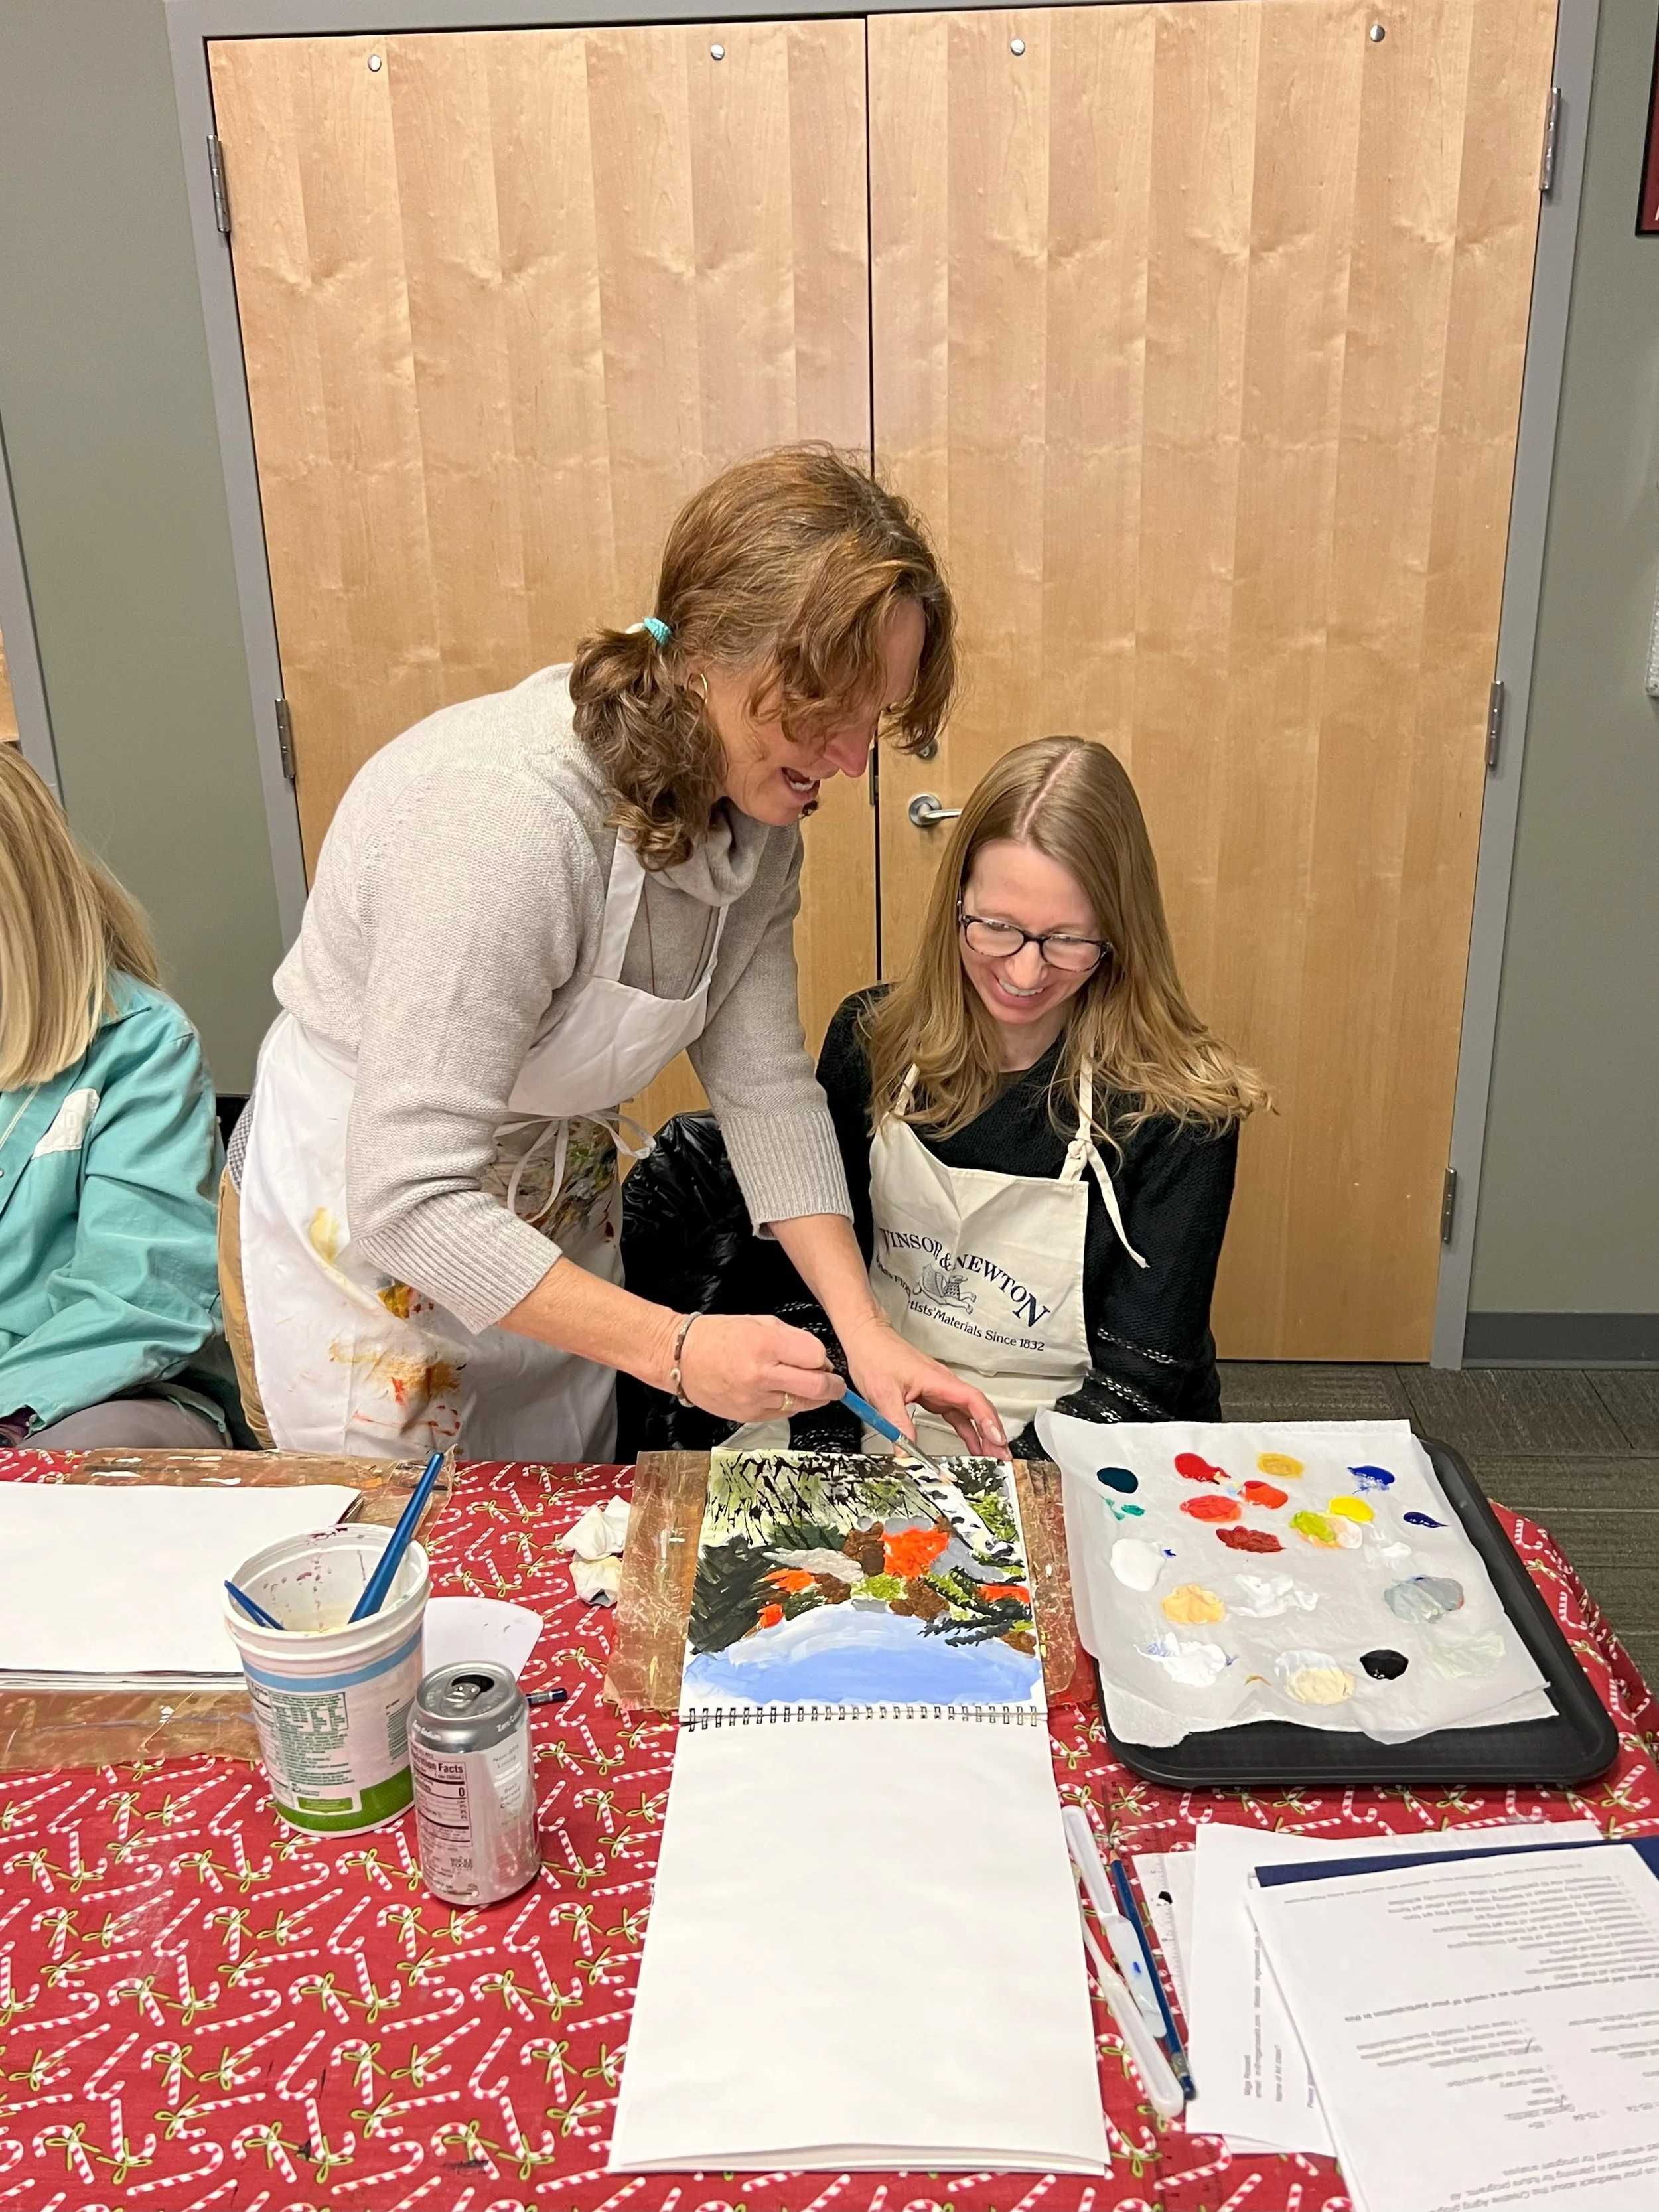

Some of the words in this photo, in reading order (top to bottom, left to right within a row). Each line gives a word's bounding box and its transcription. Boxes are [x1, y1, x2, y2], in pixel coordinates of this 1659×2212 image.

[939, 1253, 952, 1271] &
[953, 1254, 1050, 1328] NEWTON
[908, 1300, 936, 1317] tists'
[934, 1310, 982, 1337] Materials
[985, 1330, 1017, 1347] Since
[1019, 1339, 1045, 1351] 1832
[438, 1763, 463, 1773] Facts
